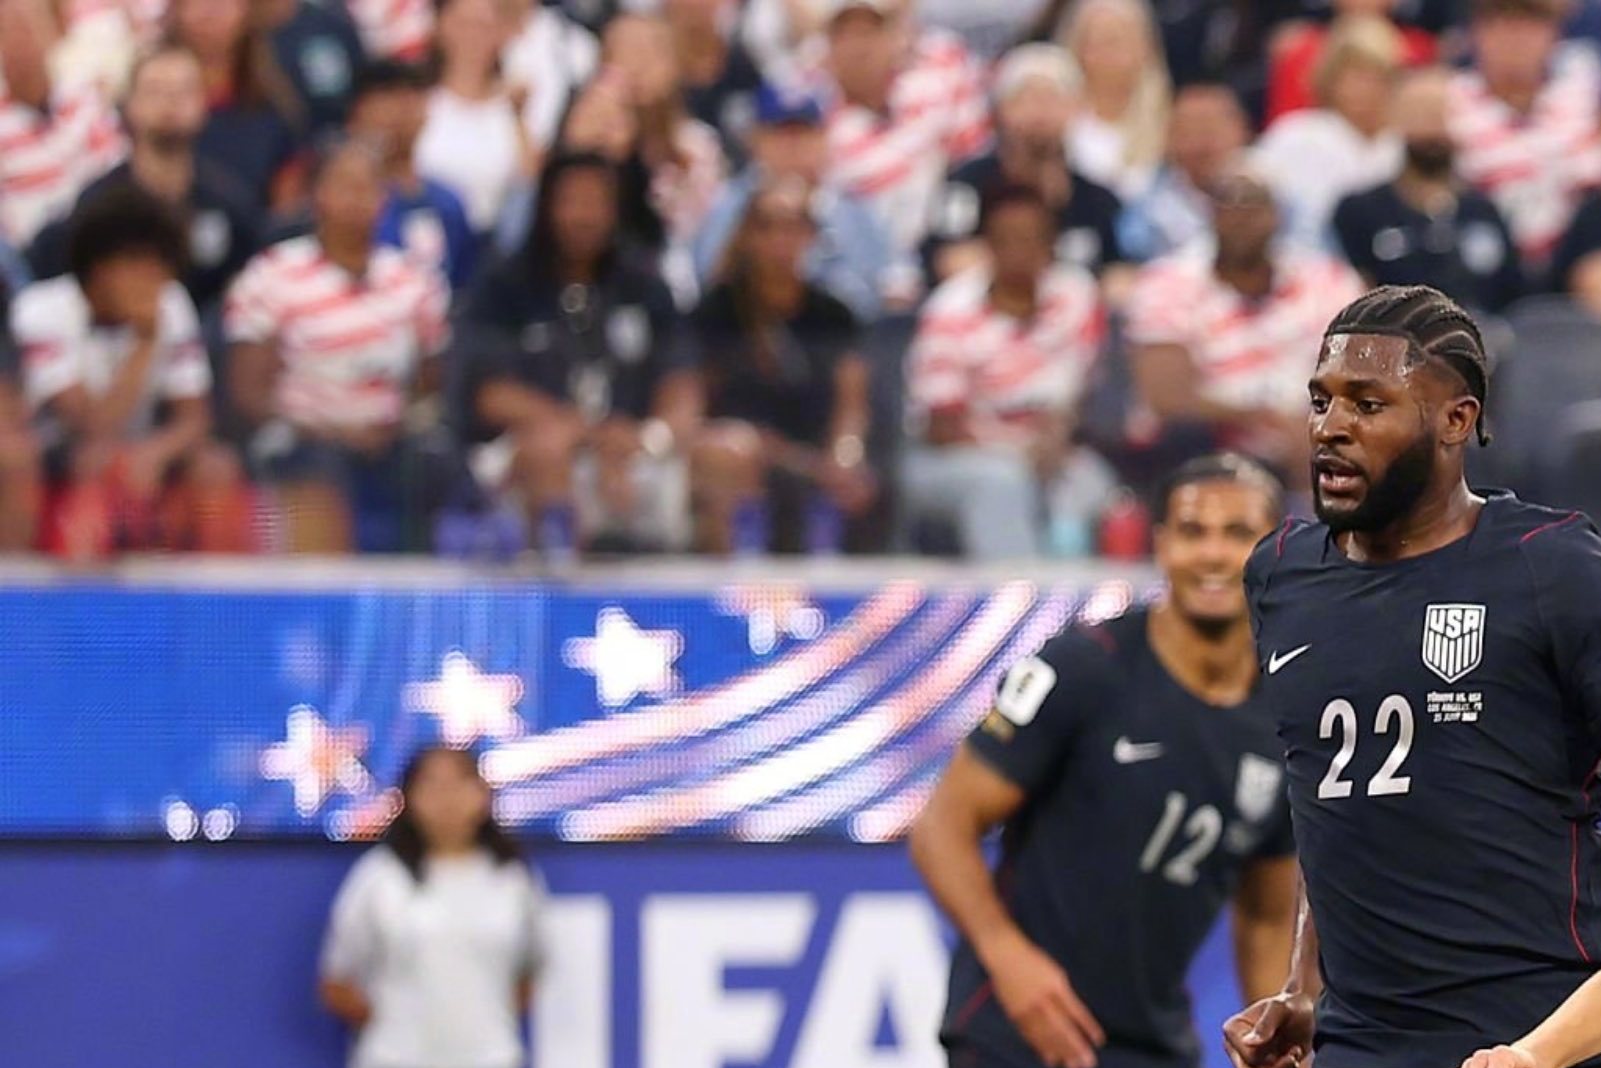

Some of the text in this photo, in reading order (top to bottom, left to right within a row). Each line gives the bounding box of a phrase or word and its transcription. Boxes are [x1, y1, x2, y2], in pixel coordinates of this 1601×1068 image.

[1429, 608, 1481, 640] USA
[1317, 693, 1415, 800] 22
[1138, 790, 1224, 888] 12
